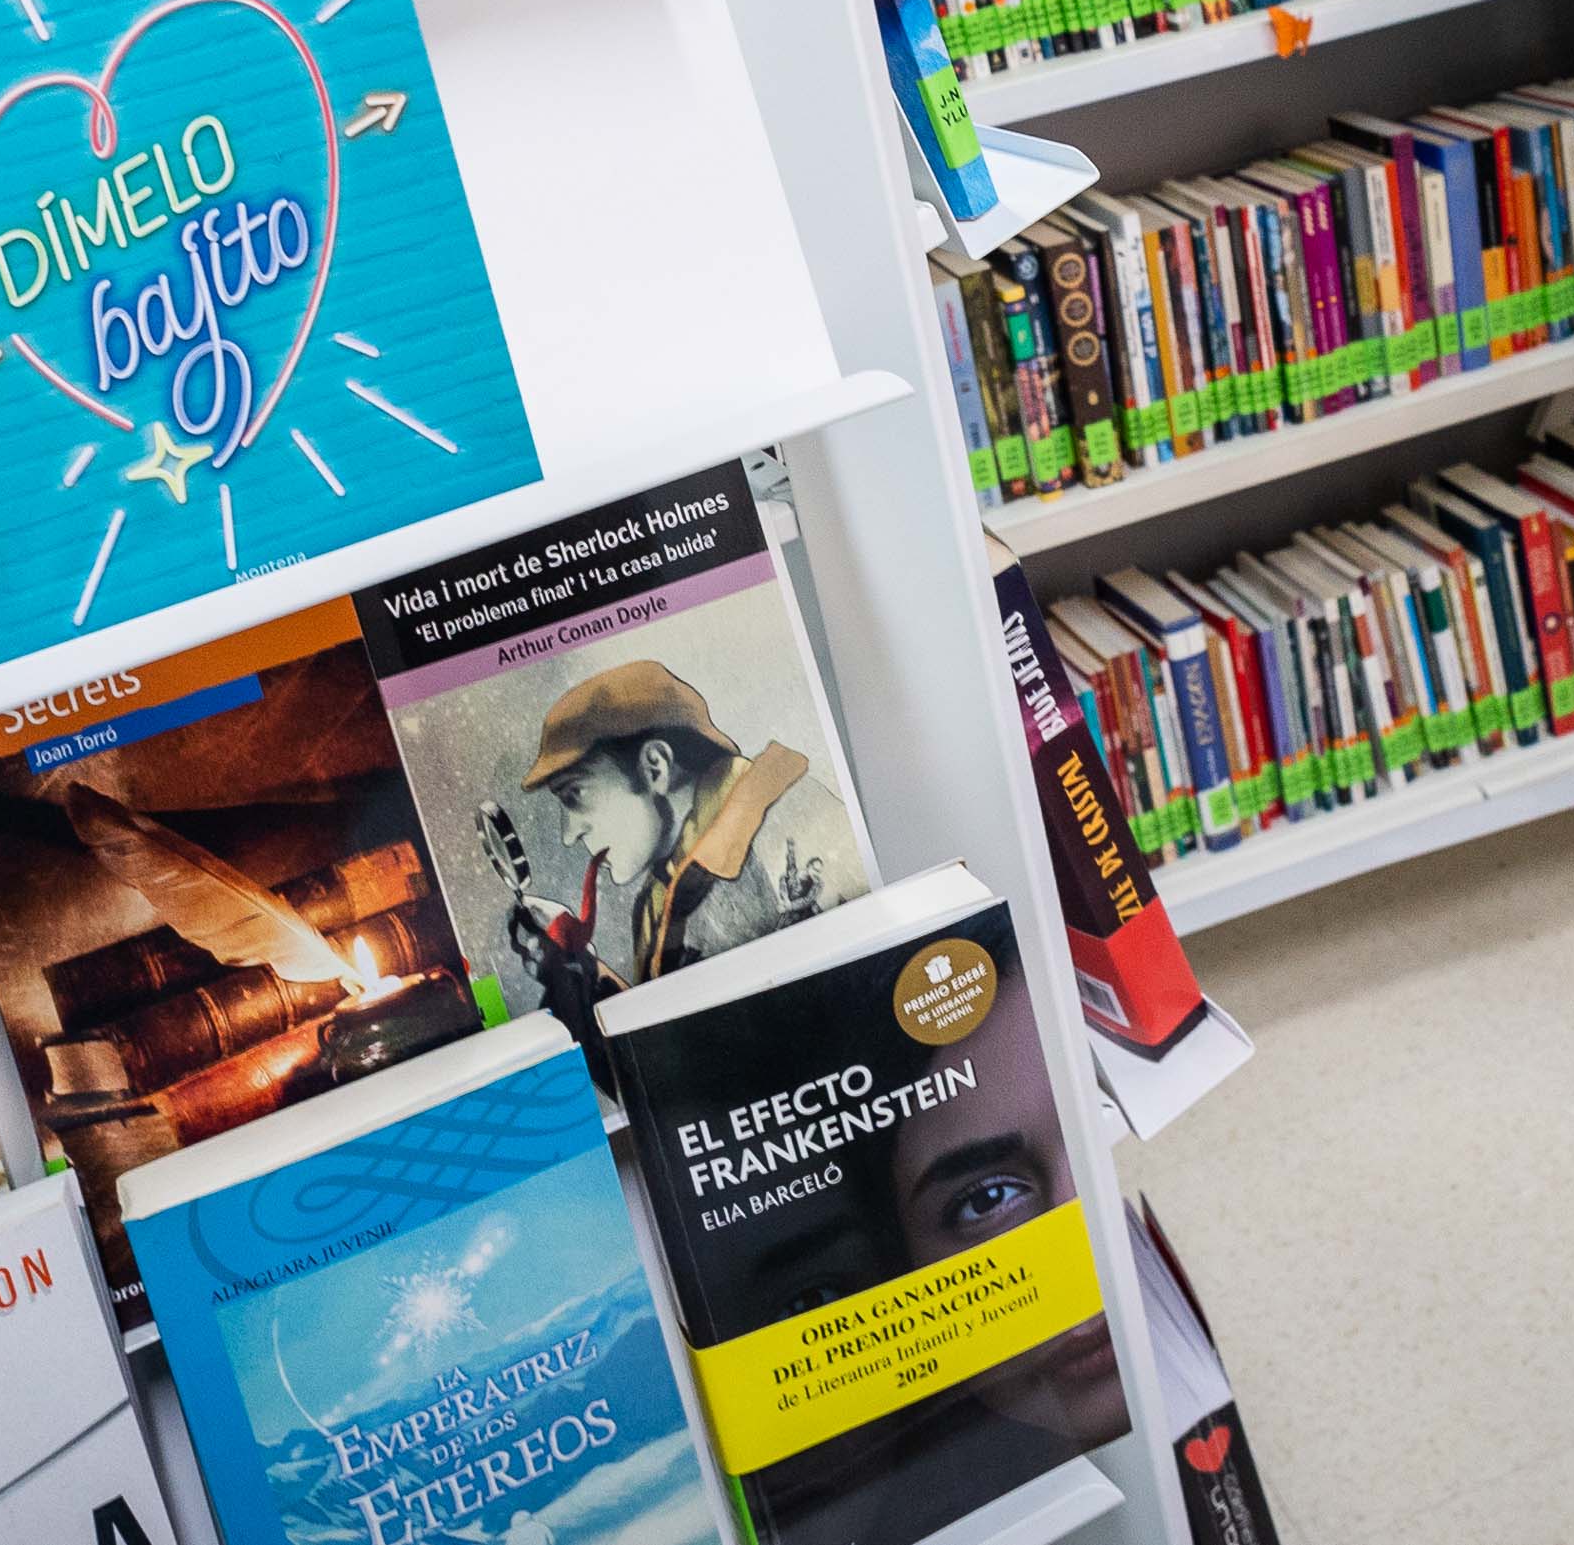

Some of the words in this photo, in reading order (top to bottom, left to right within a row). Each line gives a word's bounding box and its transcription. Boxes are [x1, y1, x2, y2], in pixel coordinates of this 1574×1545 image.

[91, 198, 311, 468] bajito
[383, 584, 440, 619] Vida
[440, 580, 451, 603] i
[455, 559, 512, 600] mort
[513, 552, 544, 580] de
[545, 517, 645, 568] Sherlock
[645, 491, 730, 535] Holmes
[444, 595, 530, 641] problema
[578, 571, 588, 592] i
[620, 552, 663, 579] casa
[496, 634, 555, 667] Arthur
[558, 613, 615, 646] Conan
[617, 595, 668, 625] Doyle
[1002, 610, 1046, 687] JEANS
[1, 667, 144, 738] Secrets
[1022, 678, 1068, 743] BLUE
[32, 734, 75, 769] Joan
[76, 721, 120, 756] Torró
[1055, 748, 1111, 848] CRISTAL
[1093, 840, 1125, 881] DE
[903, 983, 951, 1016] PREMIO
[950, 960, 988, 992] EDEBÉ
[916, 1010, 933, 1025] DE
[930, 983, 985, 1019] LITERATURA
[935, 1002, 976, 1031] JUVENIL
[677, 1120, 725, 1159] EL
[728, 1063, 874, 1142] EFECTO
[688, 1058, 979, 1198] FRANKENSTEIN
[701, 1202, 747, 1233] ELIA
[749, 1160, 844, 1216] BARCELÓ
[210, 1256, 321, 1307] ALFAGUARA
[322, 1219, 400, 1266] JUVENIL
[772, 1355, 822, 1386] DEL
[825, 1316, 916, 1365] PREMIO
[920, 1265, 1035, 1322] NACIONAL
[801, 1309, 867, 1348] OBRA
[871, 1256, 999, 1319] GANADORA
[435, 1365, 469, 1395] LA
[776, 1390, 800, 1413] de
[804, 1355, 895, 1403] Literatura
[896, 1323, 960, 1363] Infantil
[962, 1320, 976, 1338] y
[978, 1286, 1041, 1326] Juvenil
[895, 1357, 940, 1390] 2020
[328, 1328, 600, 1483] EMPERATRIZ
[430, 1438, 466, 1470] DE
[471, 1409, 519, 1448] LOS
[349, 1398, 619, 1545] ETÉREOS
